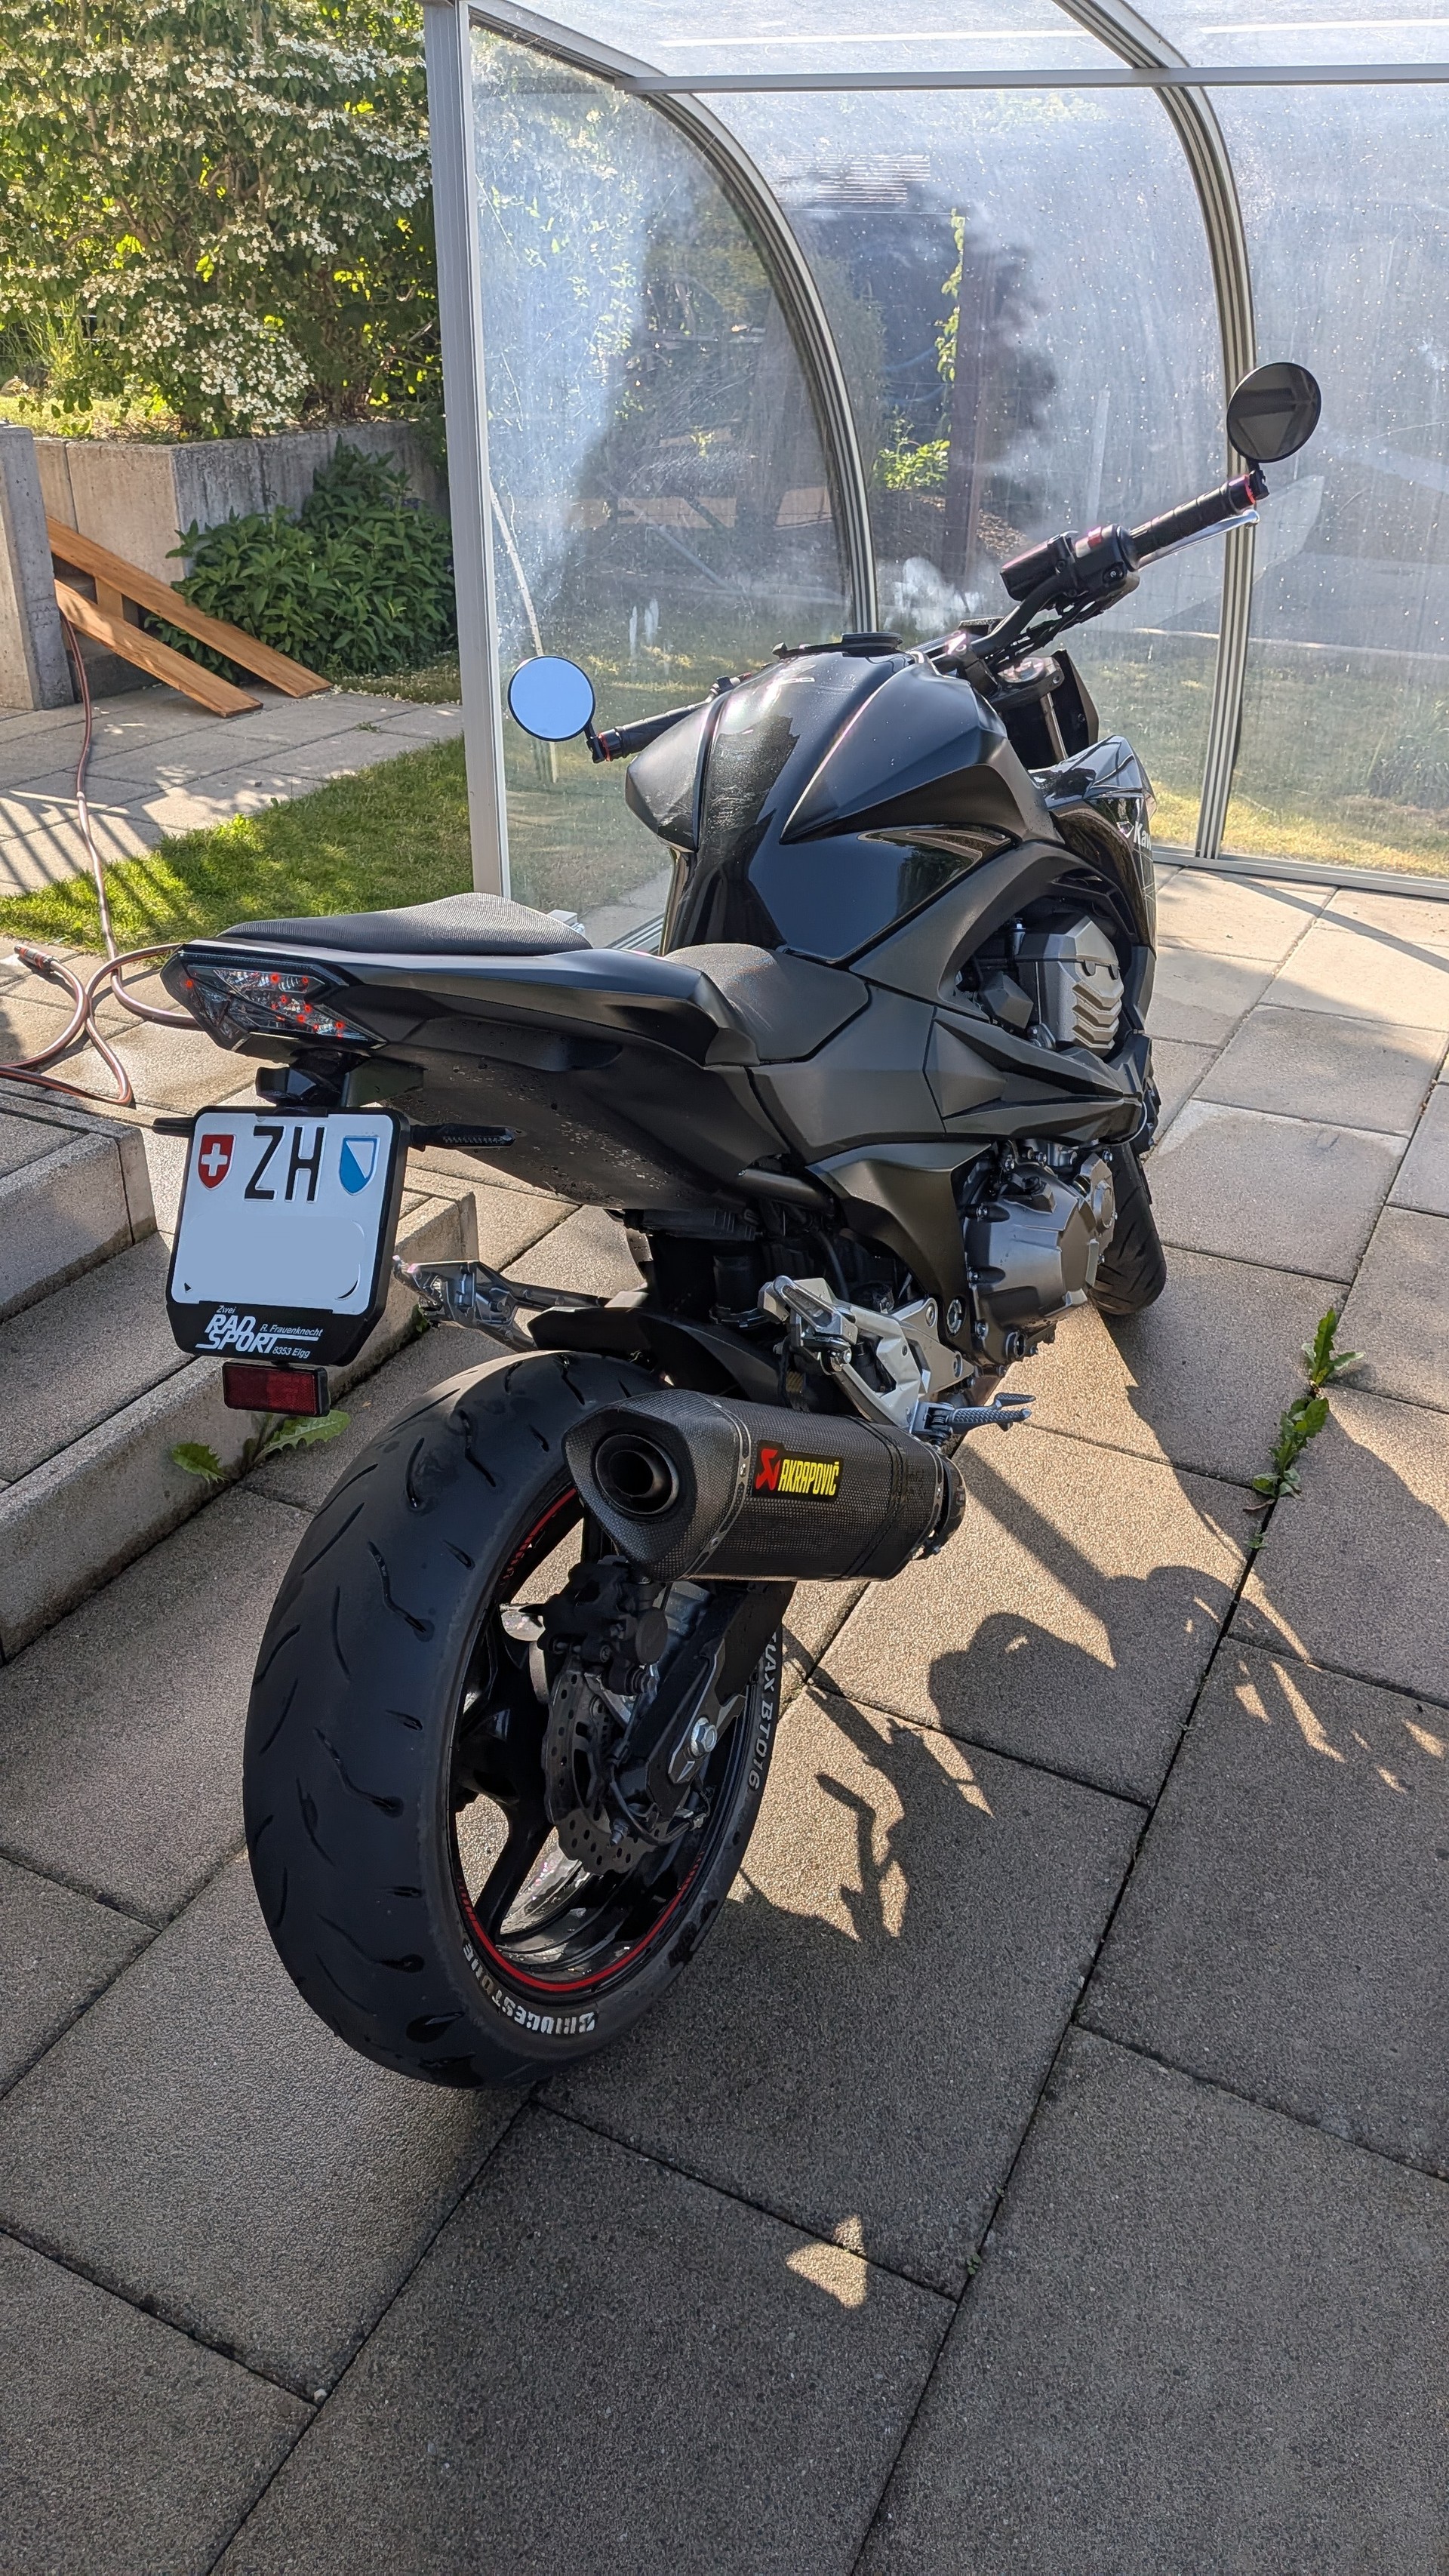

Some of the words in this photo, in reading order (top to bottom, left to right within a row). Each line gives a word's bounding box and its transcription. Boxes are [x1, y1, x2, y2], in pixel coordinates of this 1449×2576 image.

[244, 1125, 325, 1202] ZH
[216, 1305, 237, 1314] Zwei
[204, 1314, 257, 1334] RAD
[260, 1324, 269, 1333] R.
[269, 1325, 323, 1337] Frauenknecht
[195, 1330, 281, 1354] SPORT
[272, 1346, 293, 1356] 8353
[291, 1348, 311, 1359] Elgg
[748, 1700, 774, 1790] BT016
